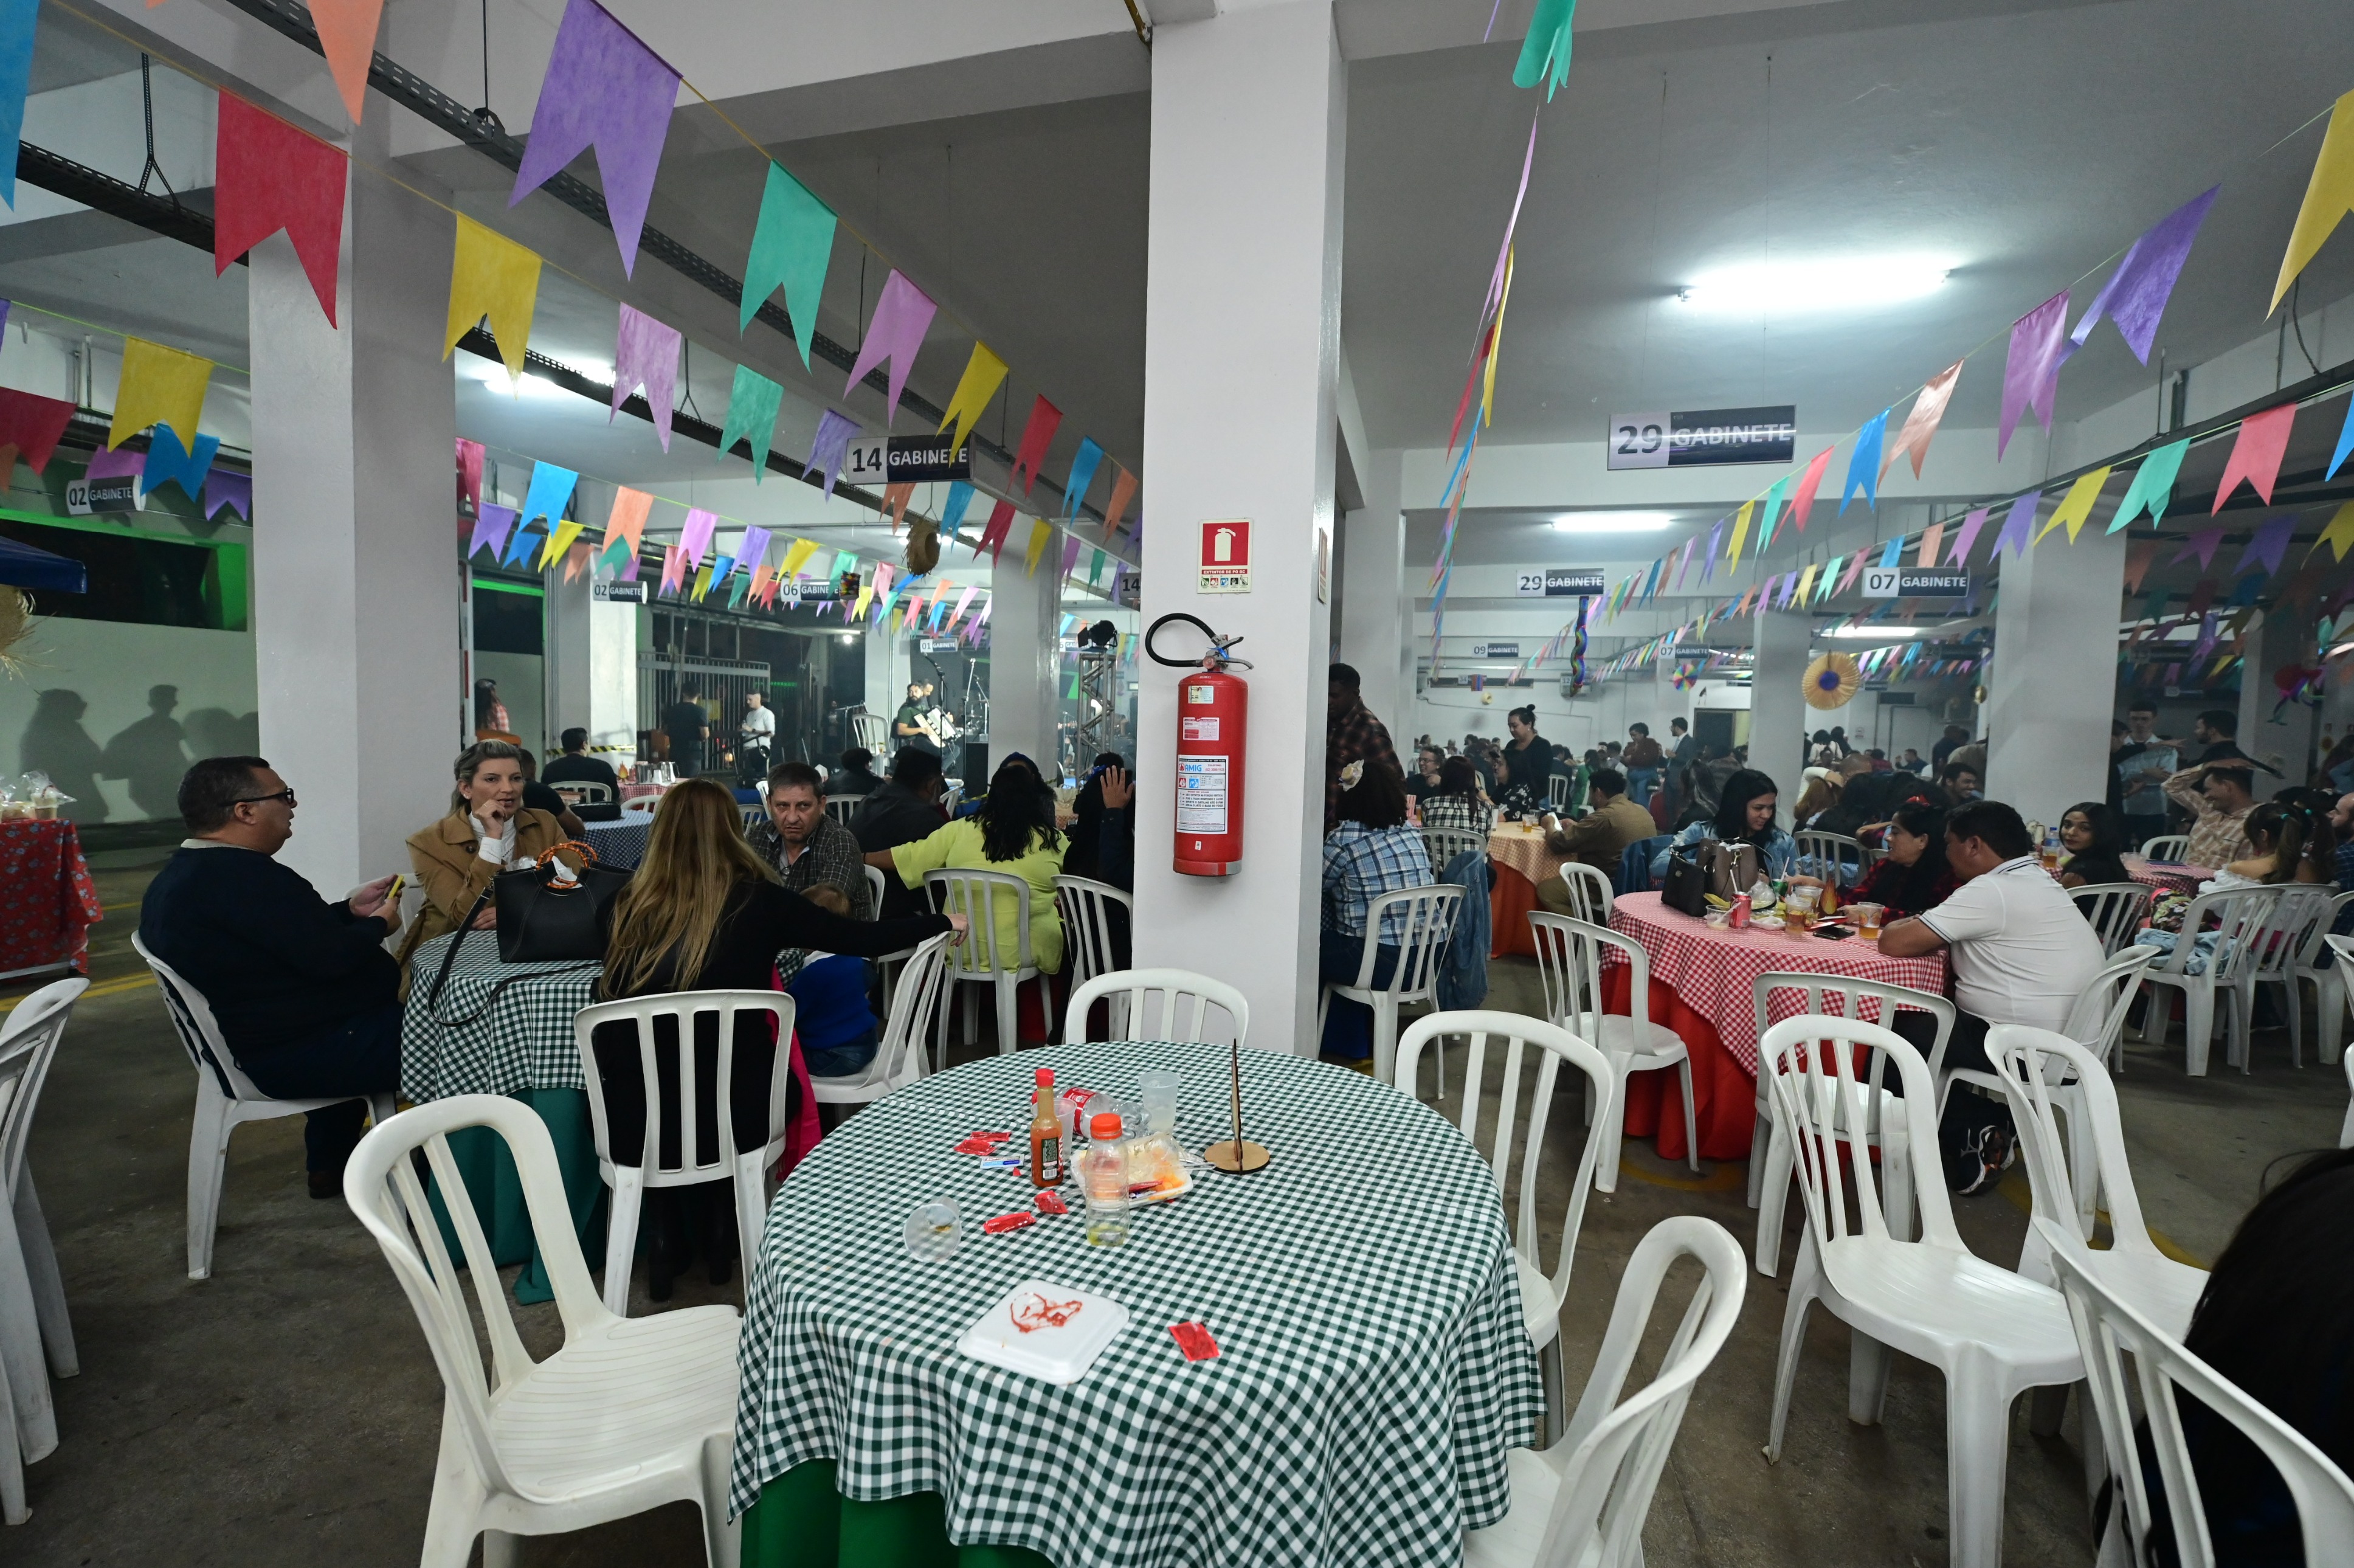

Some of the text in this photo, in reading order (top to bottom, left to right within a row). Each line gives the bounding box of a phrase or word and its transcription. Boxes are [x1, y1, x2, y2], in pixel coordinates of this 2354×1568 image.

[1618, 423, 1791, 454] 29 GABINETE
[852, 447, 882, 472] 14
[69, 487, 132, 506] 02 GABINETE
[1122, 578, 1141, 592] 14
[1520, 576, 1603, 590] 29 GABINETE
[1869, 574, 1967, 589] 07 GABINETE
[595, 584, 607, 596] 02
[783, 584, 798, 596] 06
[1660, 647, 1673, 655] 07
